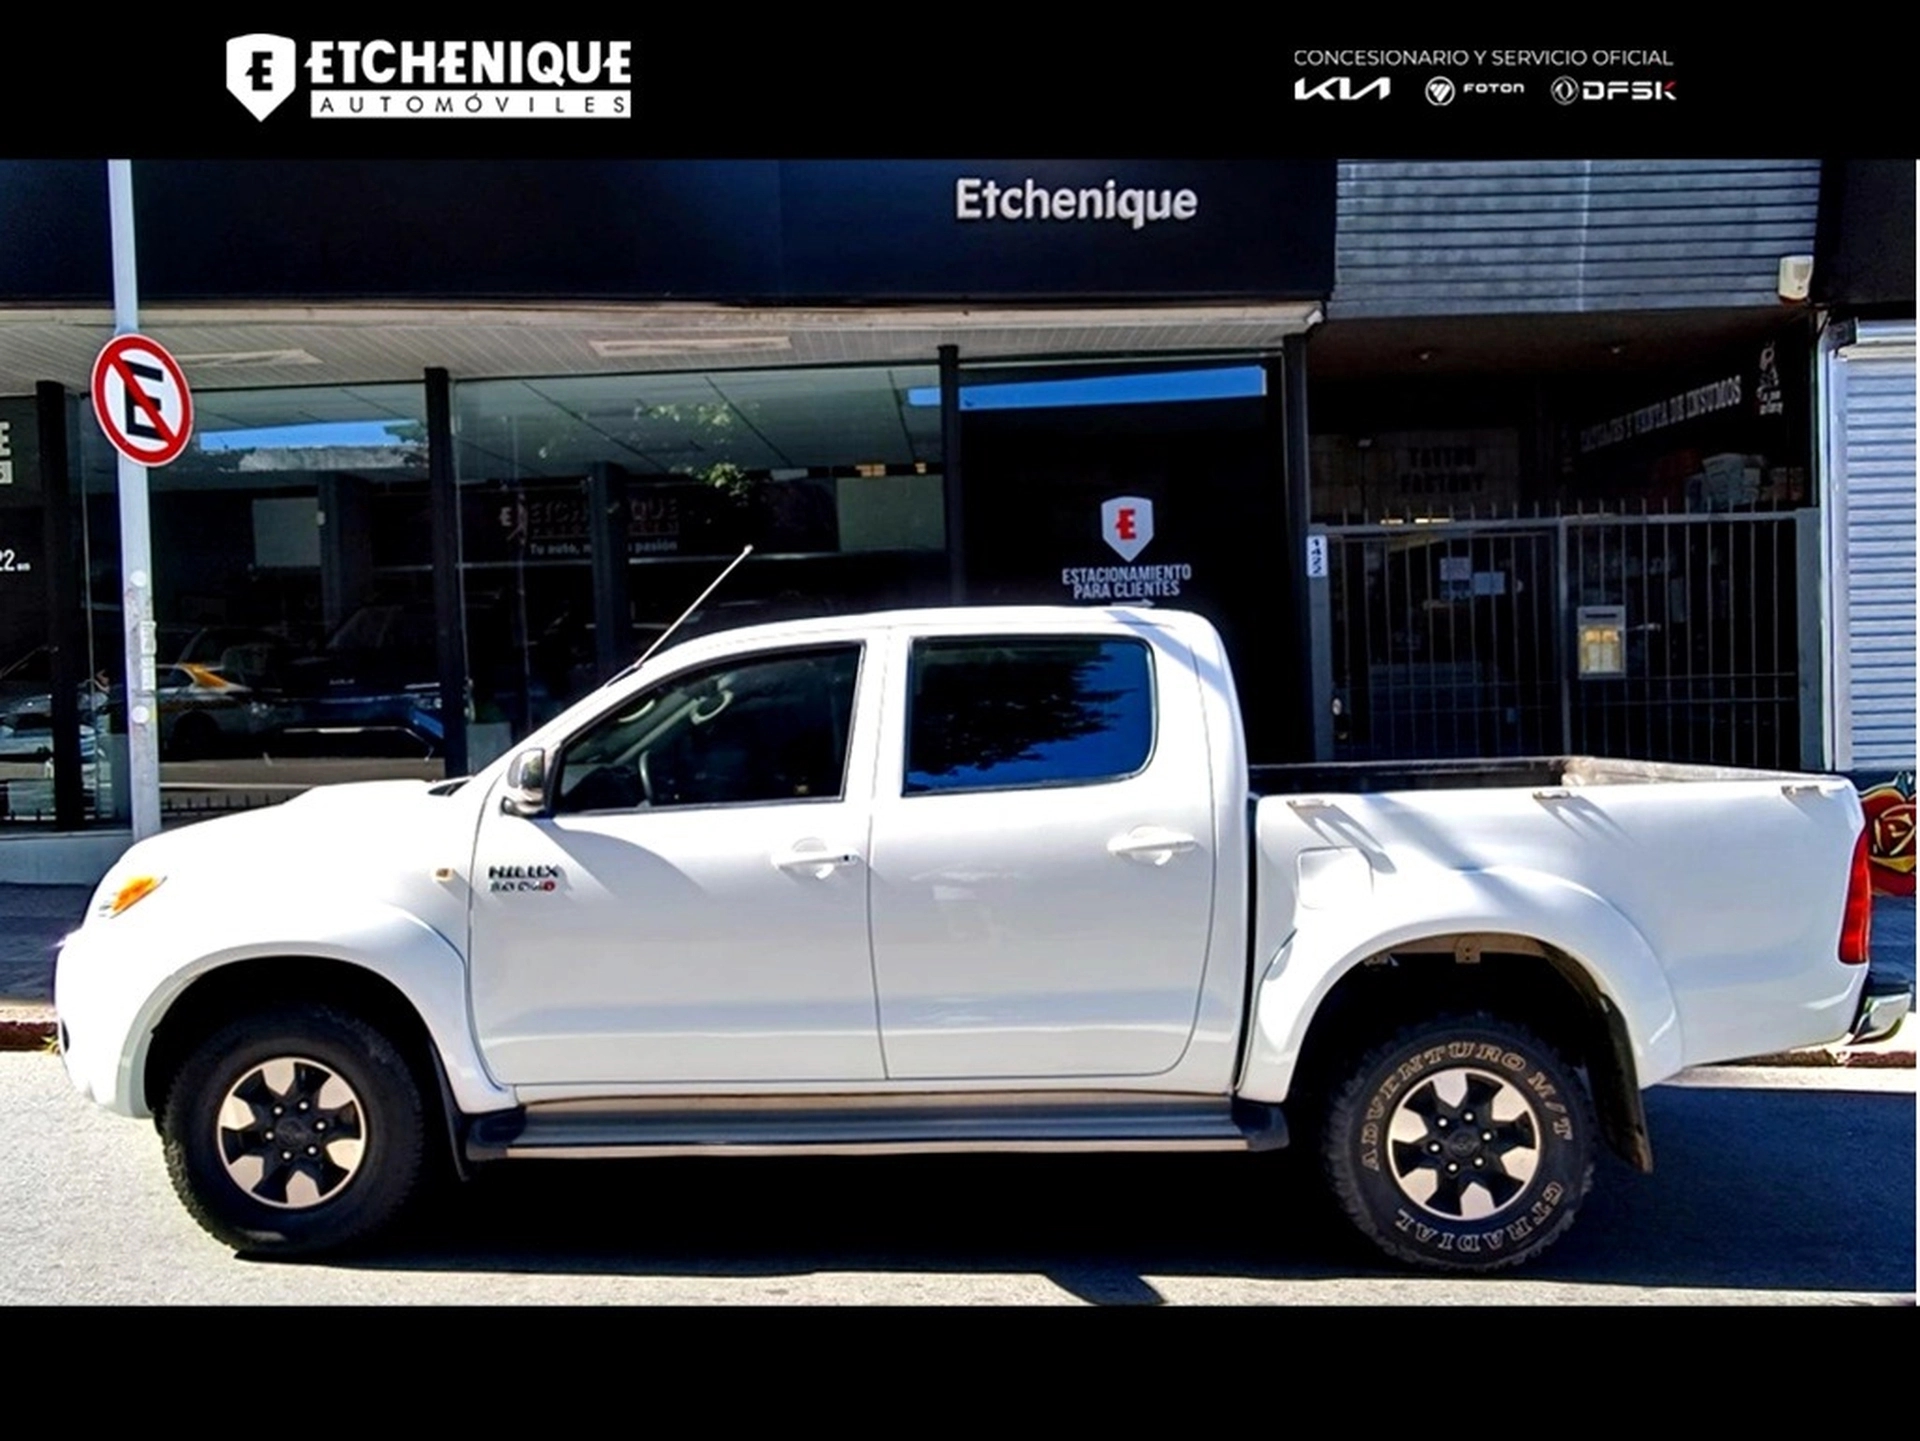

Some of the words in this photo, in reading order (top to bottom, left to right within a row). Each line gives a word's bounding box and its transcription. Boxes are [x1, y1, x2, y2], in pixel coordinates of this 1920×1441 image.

[957, 178, 1198, 230] Etchenique
[122, 358, 169, 441] E
[1062, 564, 1192, 585] ESTACIONAMIENTO
[1074, 583, 1111, 599] PARA
[1113, 580, 1181, 598] CLIENTES
[1361, 1042, 1526, 1171] ADVENTURO
[1528, 1071, 1573, 1142] M/T
